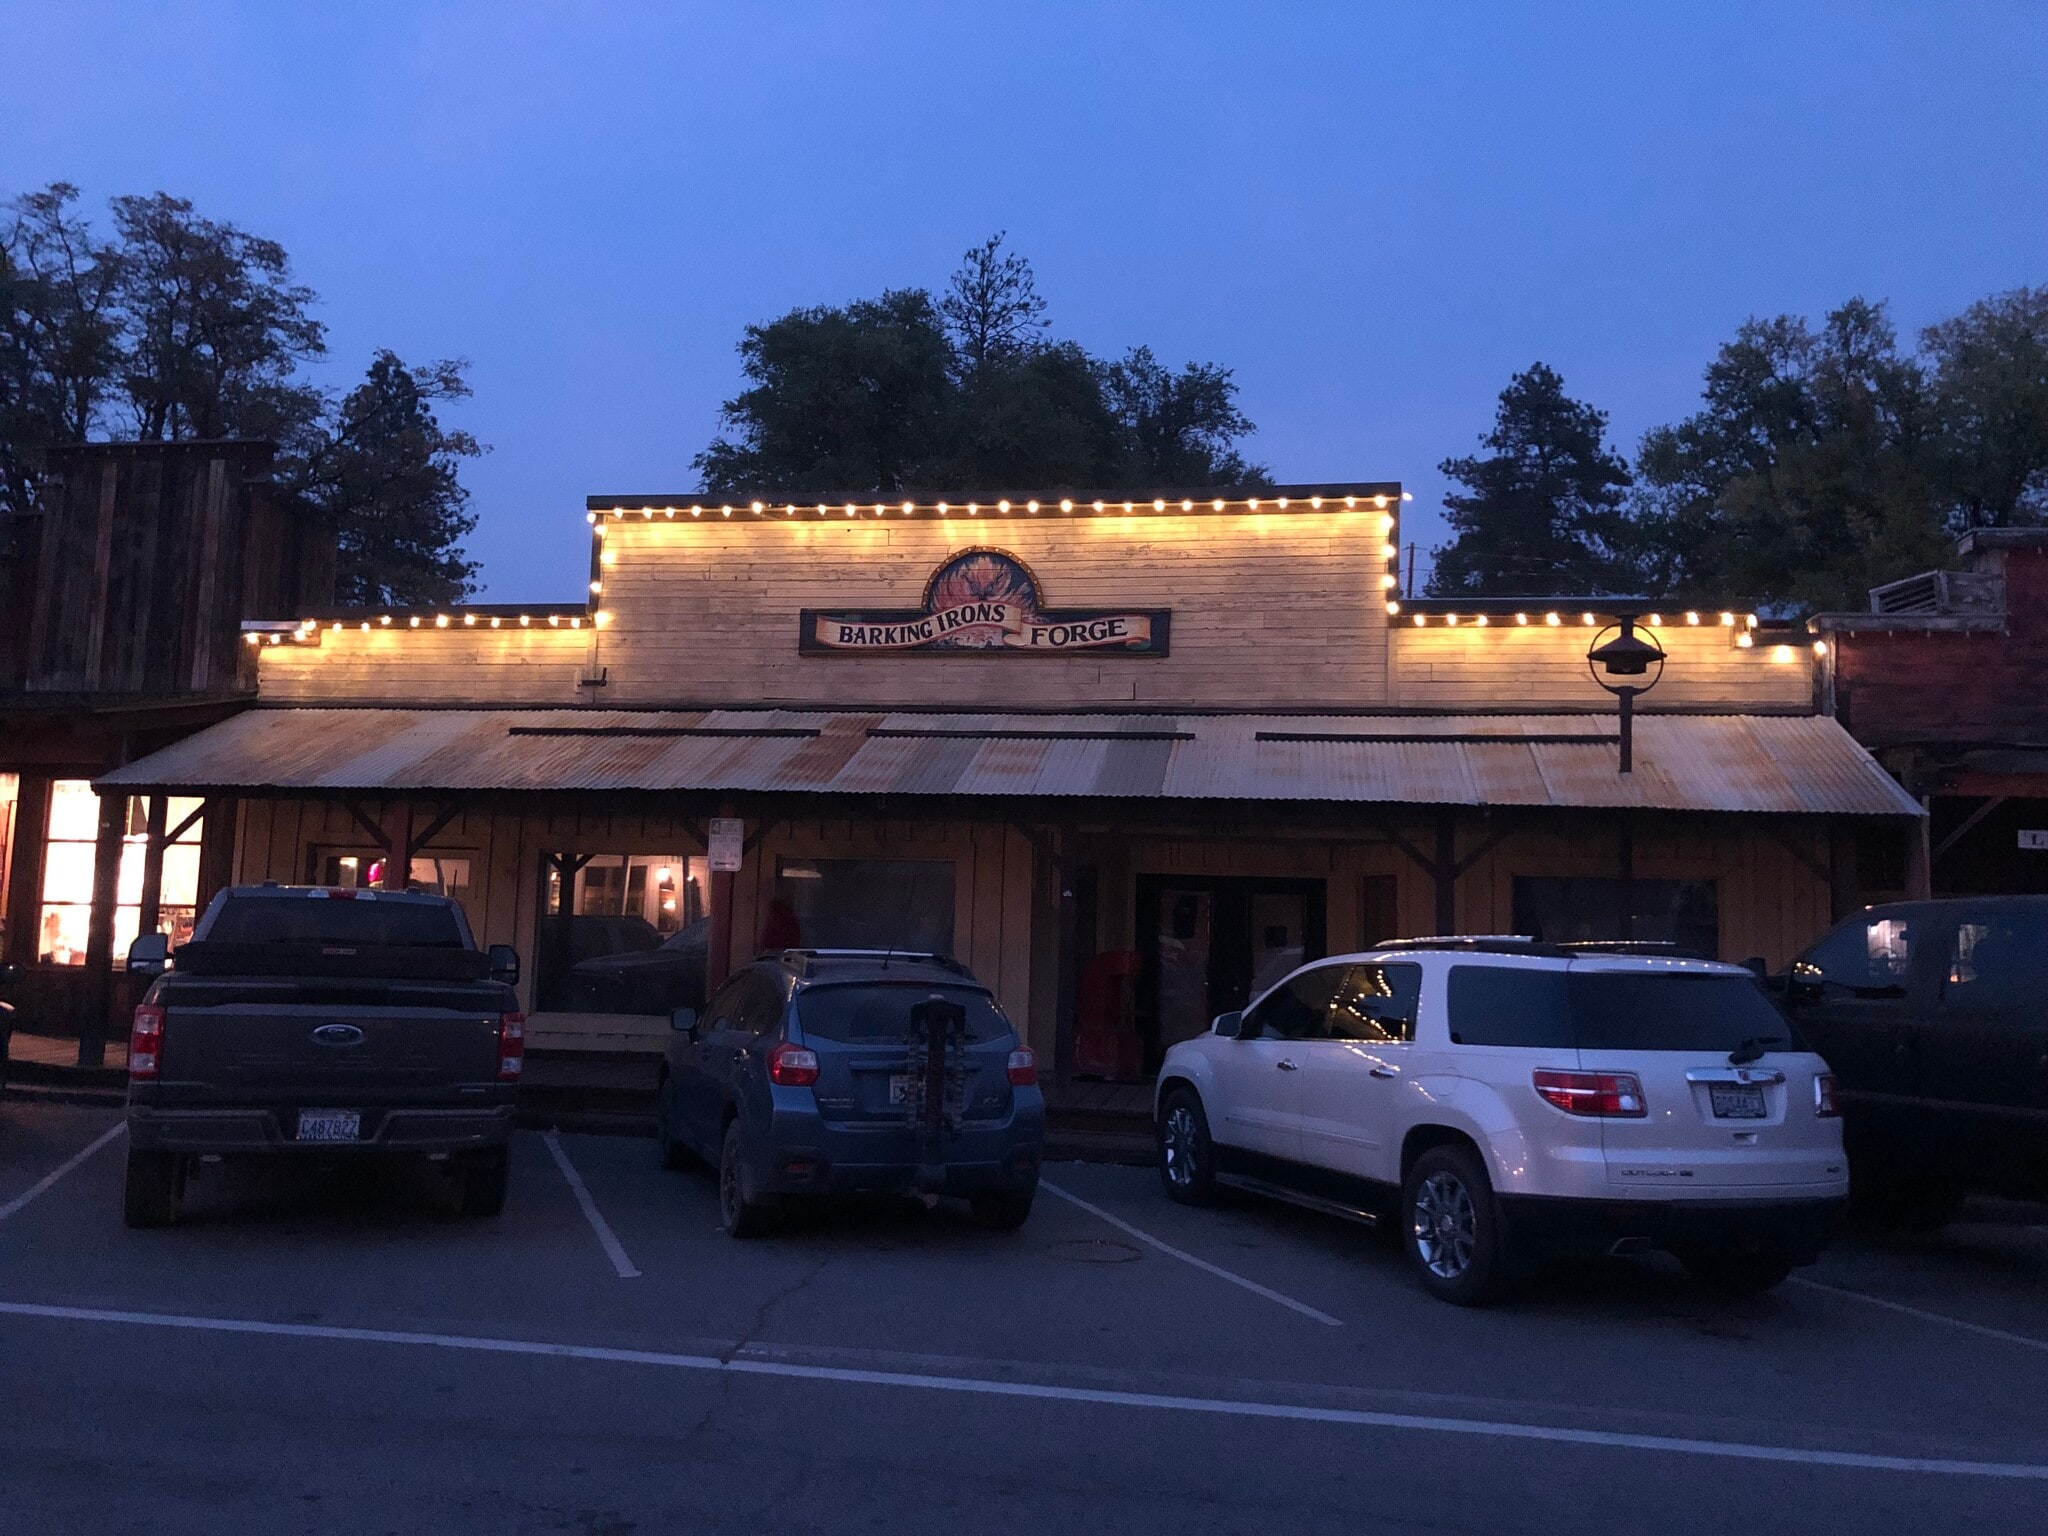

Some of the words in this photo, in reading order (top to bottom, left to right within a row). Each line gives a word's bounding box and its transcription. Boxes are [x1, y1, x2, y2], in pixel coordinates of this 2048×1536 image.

[839, 621, 933, 645] BARKING
[936, 603, 1006, 632] IRONS
[1030, 619, 1128, 647] FORGE
